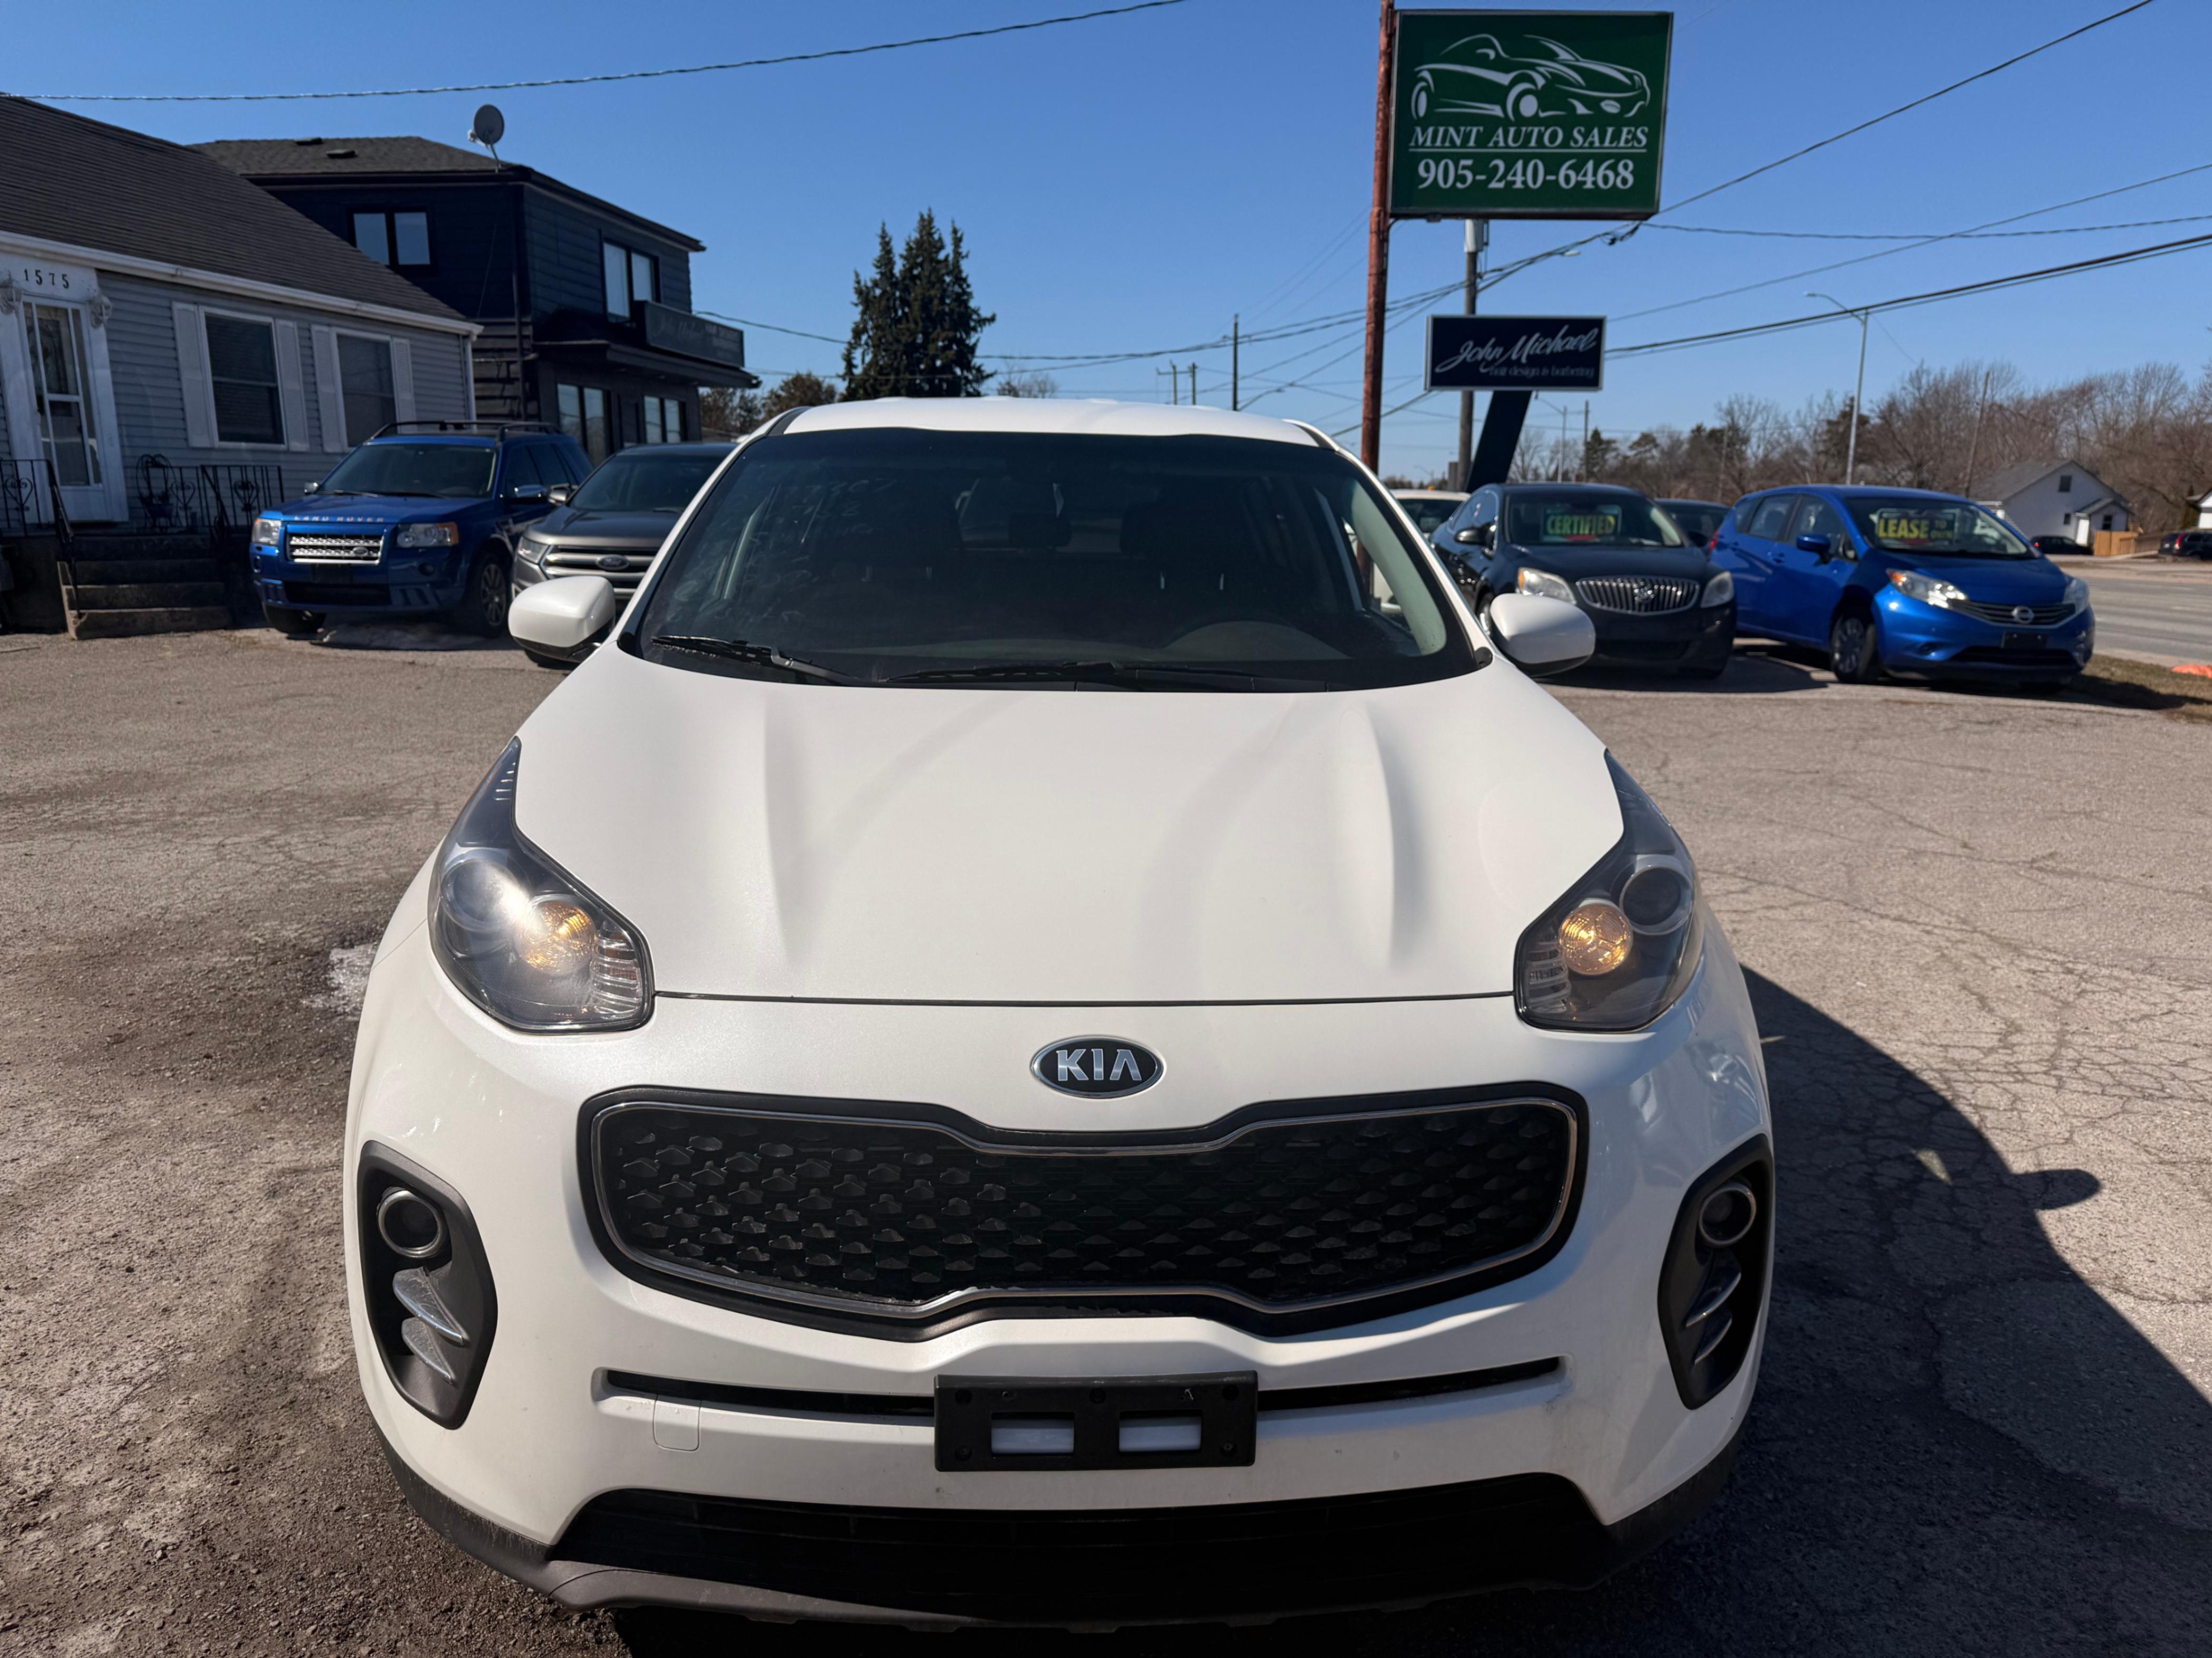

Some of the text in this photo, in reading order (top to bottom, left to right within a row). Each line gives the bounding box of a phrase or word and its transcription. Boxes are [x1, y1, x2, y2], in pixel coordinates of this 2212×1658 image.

[1409, 126, 1649, 147] MINT AUTO SALES
[1418, 159, 1634, 189] 905-240-6468
[24, 269, 69, 289] 1575
[1435, 324, 1599, 373] John Michael
[1509, 365, 1540, 379] design
[1547, 515, 1615, 535] CERTIFIED
[1878, 518, 1930, 539] LEASE
[1056, 1049, 1142, 1081] KIA
